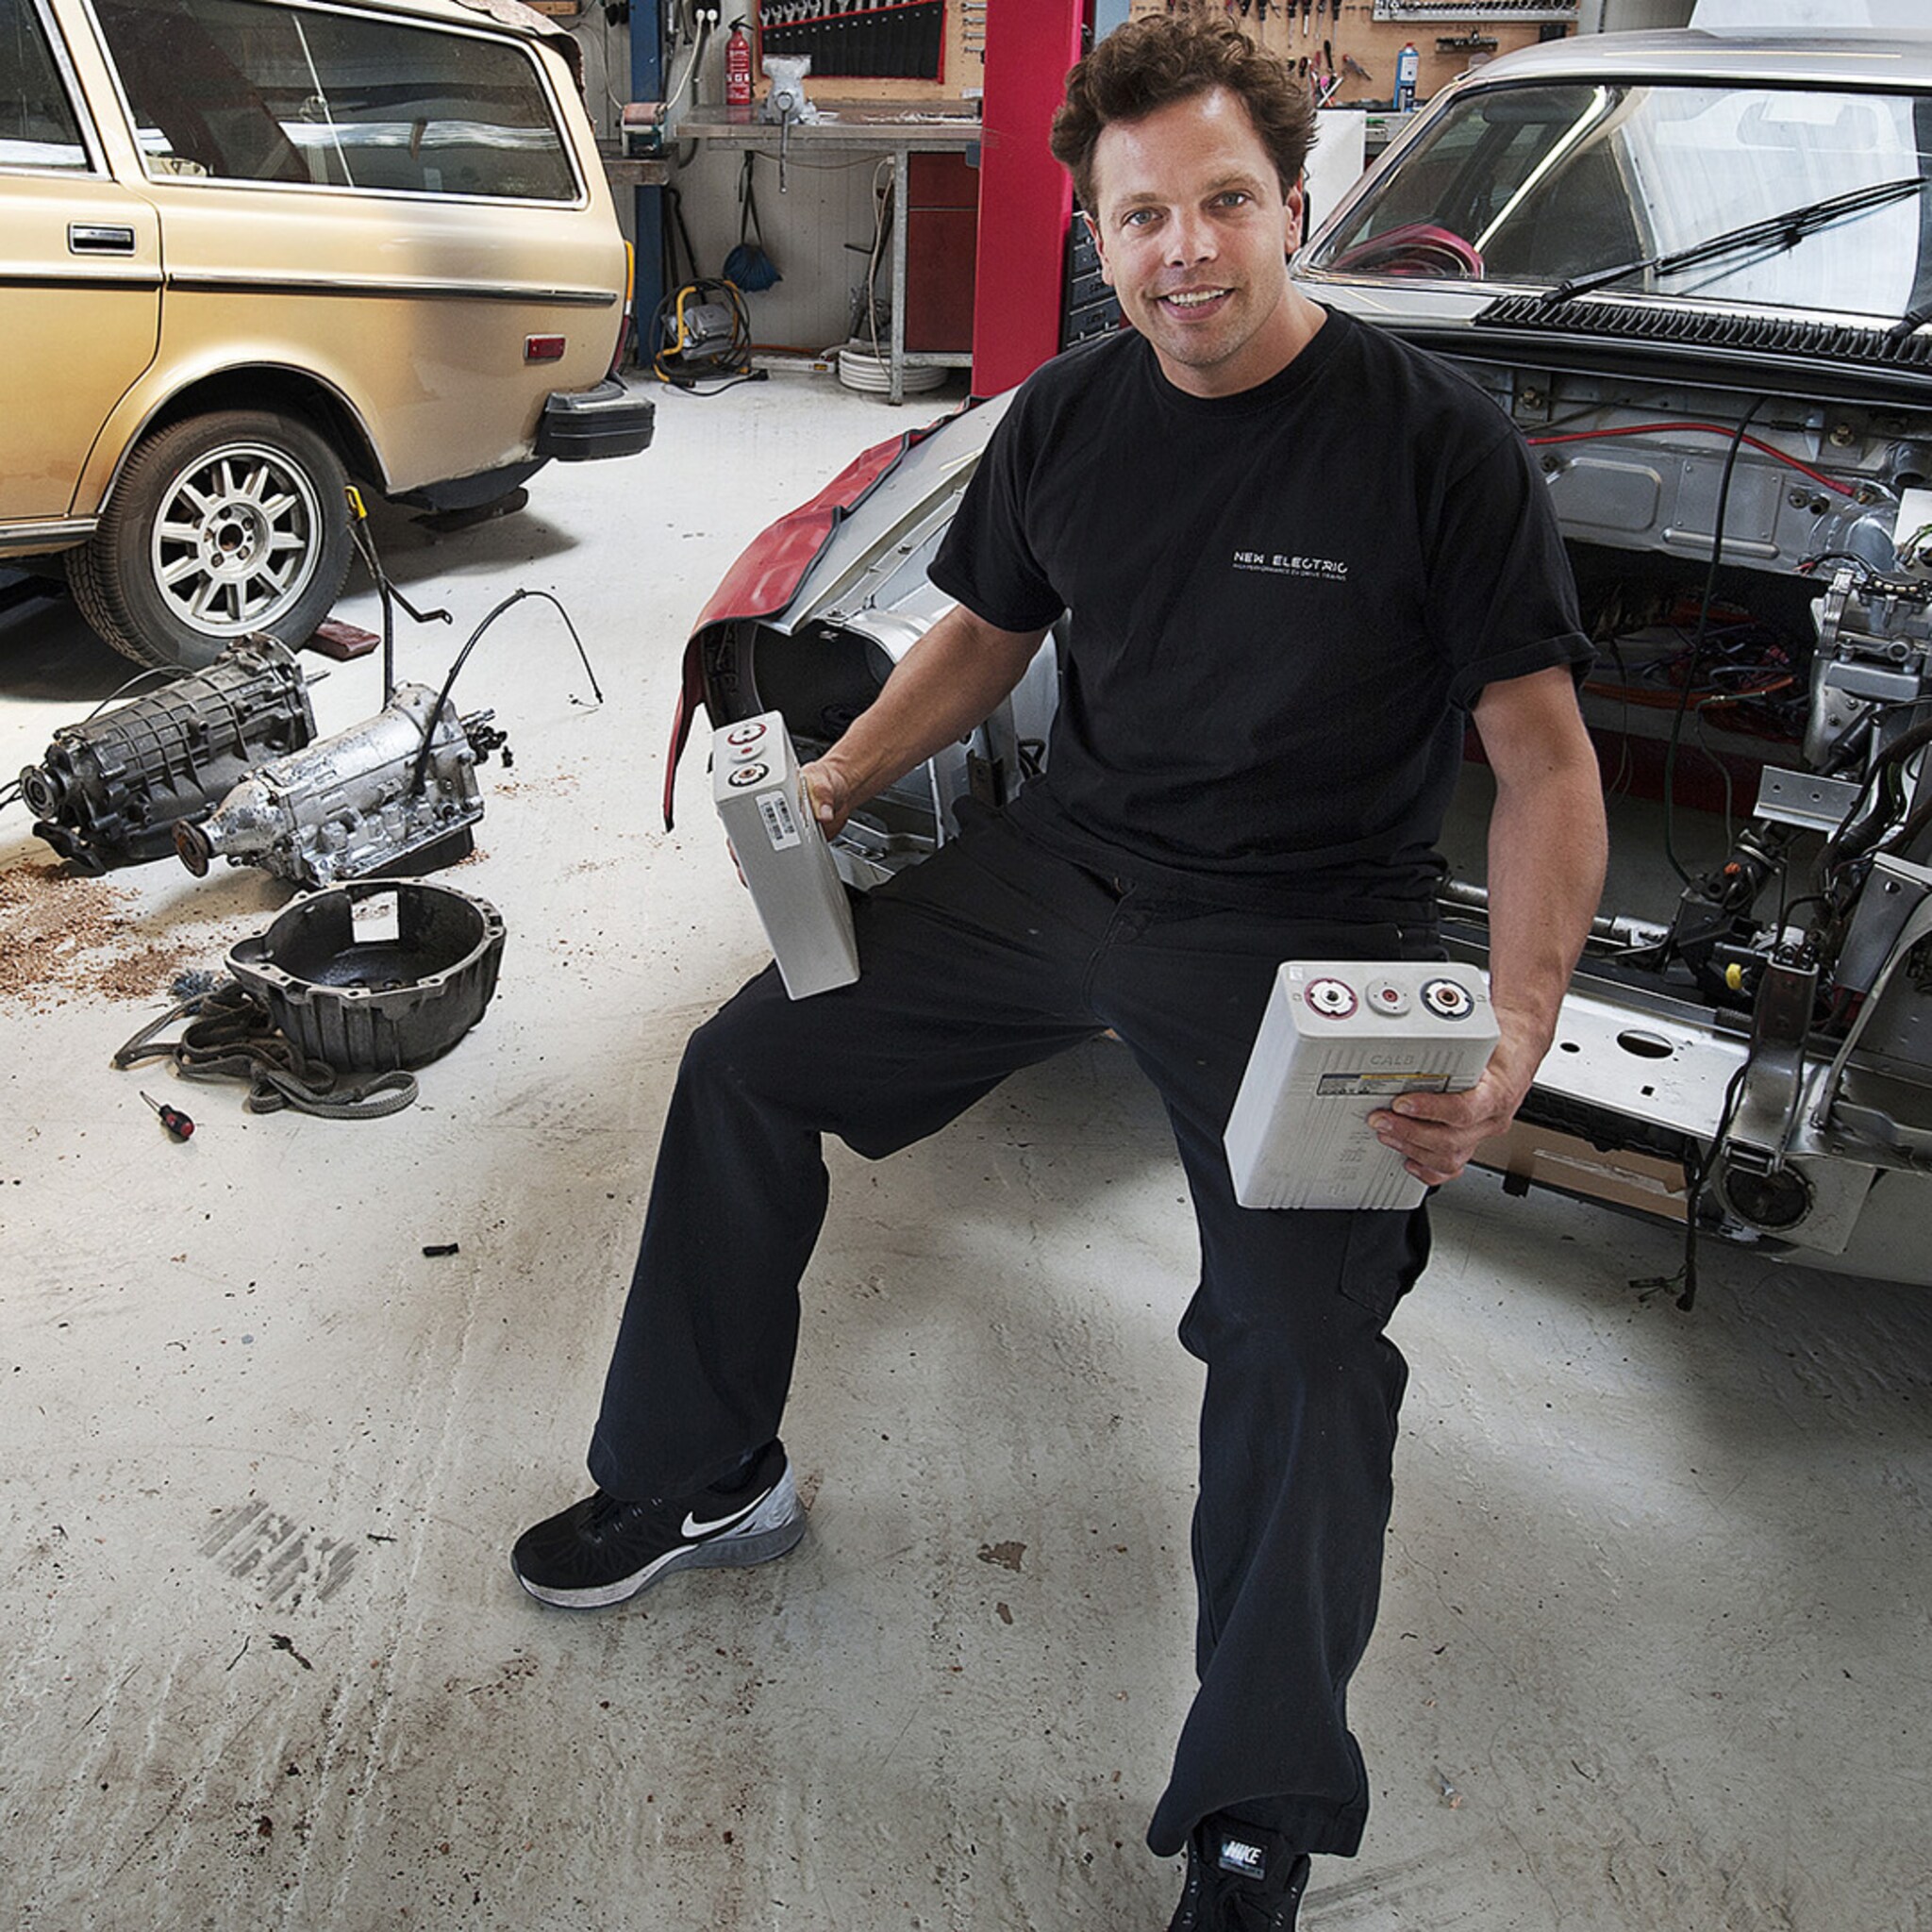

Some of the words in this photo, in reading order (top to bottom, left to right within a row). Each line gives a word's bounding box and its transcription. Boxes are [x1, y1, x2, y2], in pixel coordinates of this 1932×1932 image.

[1233, 551, 1264, 564] NEW
[1272, 555, 1348, 574] ELECTRIC
[1224, 1840, 1262, 1865] NIKE
